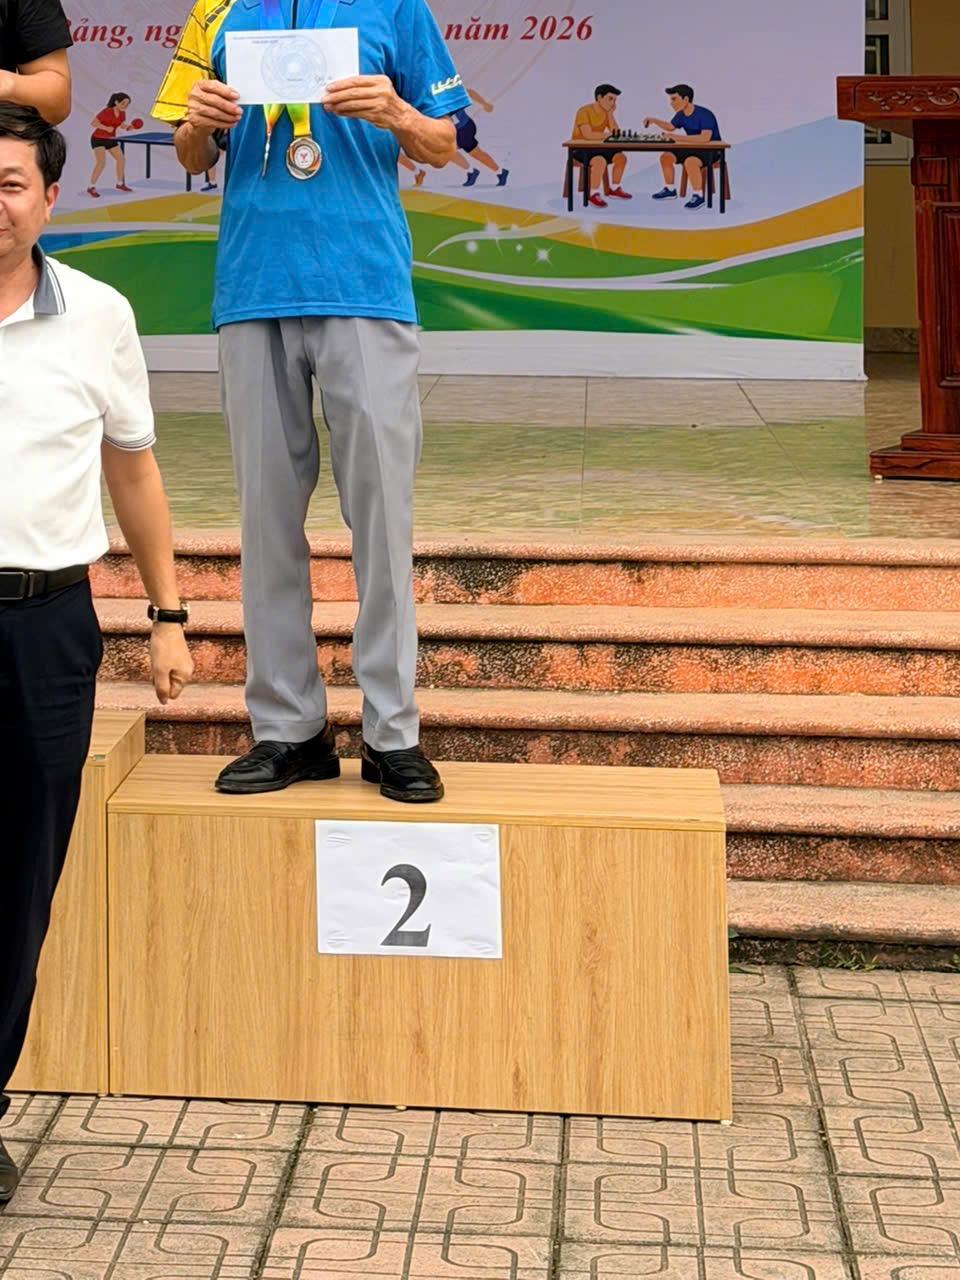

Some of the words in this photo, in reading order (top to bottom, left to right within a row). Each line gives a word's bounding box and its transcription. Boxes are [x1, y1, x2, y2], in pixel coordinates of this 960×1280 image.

[65, 18, 133, 49] ảng,
[444, 16, 509, 41] năm
[520, 15, 594, 41] 2026
[380, 863, 432, 948] 2
